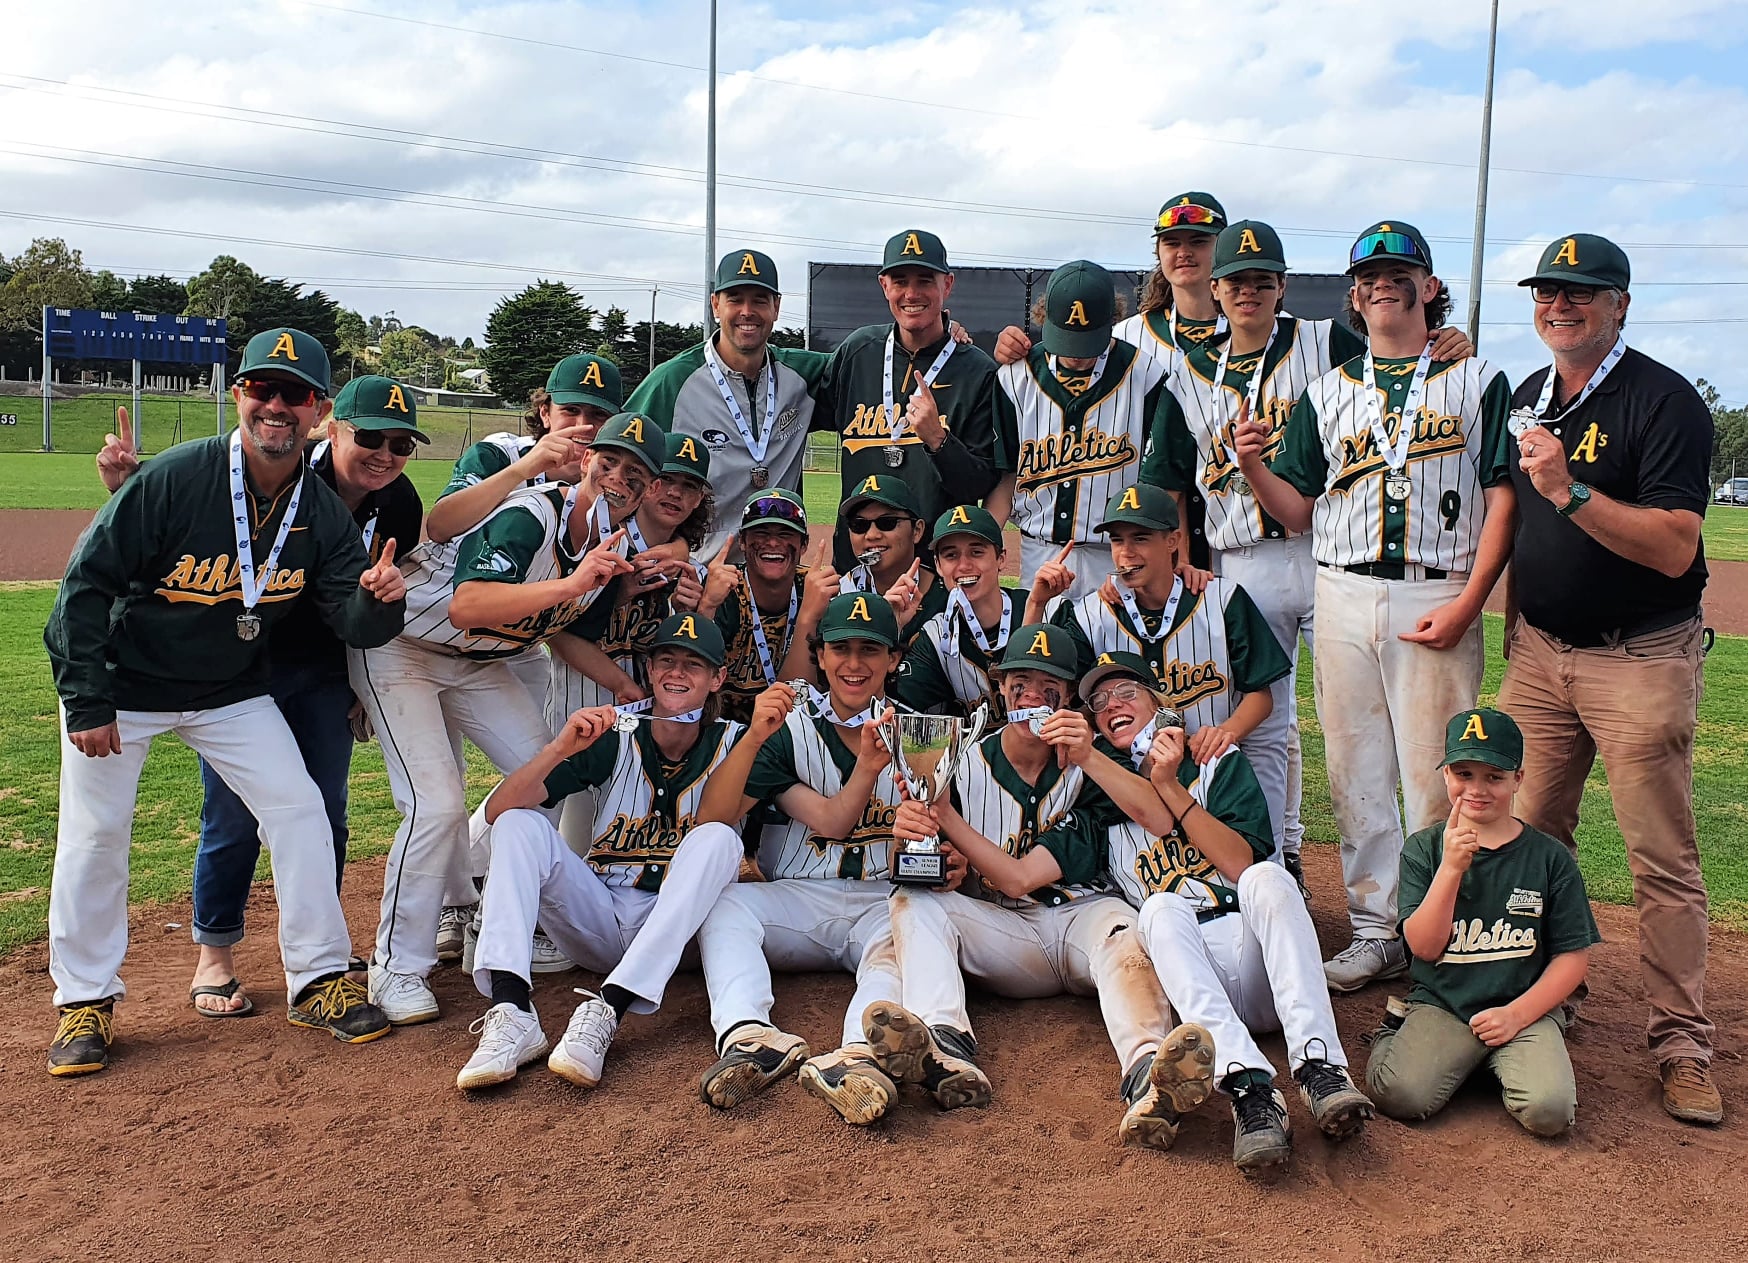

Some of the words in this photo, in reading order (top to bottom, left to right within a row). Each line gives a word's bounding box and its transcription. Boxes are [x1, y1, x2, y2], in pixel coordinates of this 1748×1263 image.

[901, 233, 923, 256] A
[1236, 229, 1261, 254] A
[1551, 238, 1580, 266] A
[737, 253, 760, 276] A
[55, 308, 71, 317] TIME
[101, 311, 117, 320] BALL
[134, 313, 158, 322] STRIKE
[175, 316, 189, 325] OUT
[1065, 300, 1089, 326] A
[267, 333, 299, 361] A
[578, 361, 605, 388] A
[384, 384, 409, 413] A
[0, 414, 16, 425] 55
[619, 417, 645, 443] A
[677, 437, 699, 462] A
[1016, 430, 1134, 478] Athletics
[860, 475, 881, 493] A
[1116, 487, 1141, 511] A
[1441, 490, 1461, 531] 9
[948, 505, 971, 526] A
[849, 597, 872, 622] A
[674, 616, 698, 640] A
[1026, 631, 1052, 657] A
[1458, 714, 1489, 741] A
[1450, 918, 1536, 952] thletics
